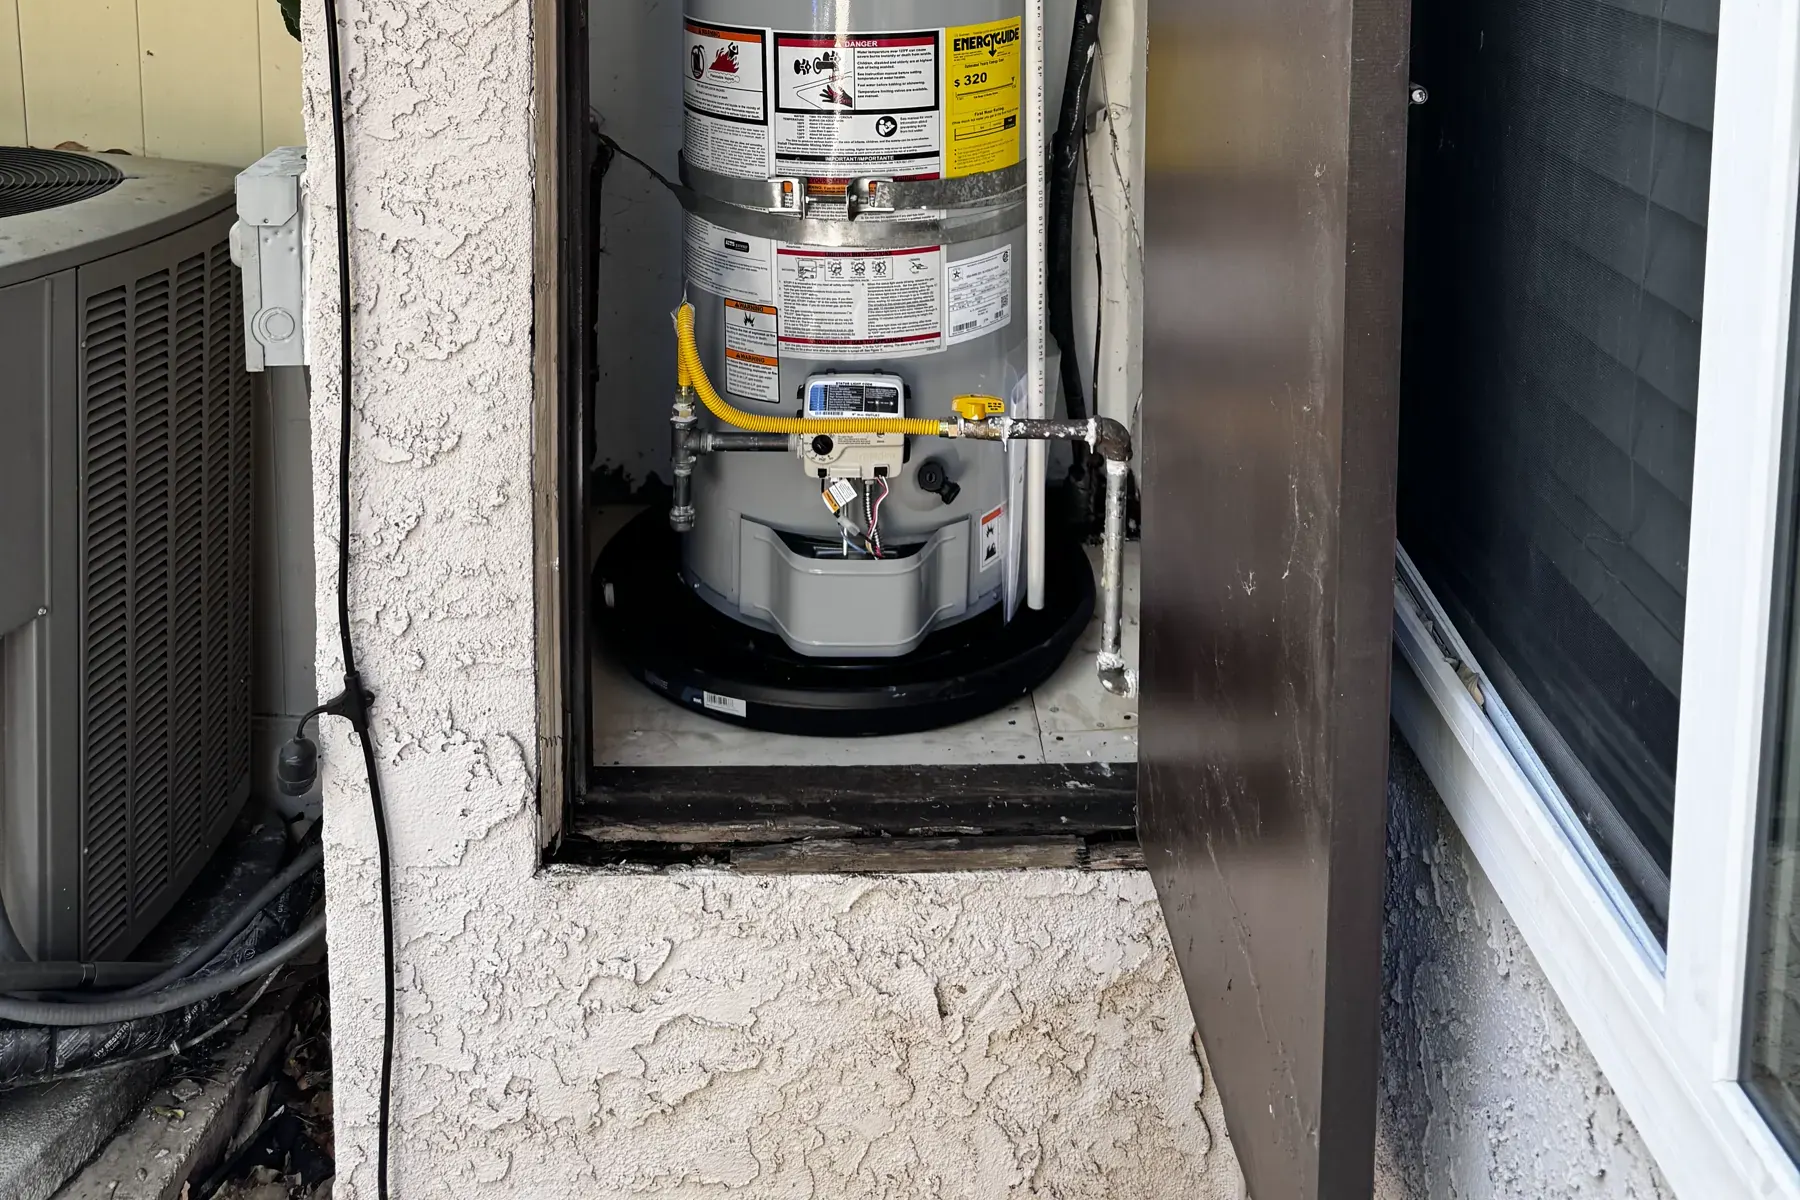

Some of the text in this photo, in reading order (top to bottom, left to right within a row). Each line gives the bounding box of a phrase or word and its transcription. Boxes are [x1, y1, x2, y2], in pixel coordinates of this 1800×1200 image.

[844, 40, 878, 48] DANGER
[953, 27, 1019, 52] ENERGYGUIDE
[954, 72, 987, 88] $ 320
[740, 302, 764, 313] WARNING
[740, 353, 765, 363] WARNING
